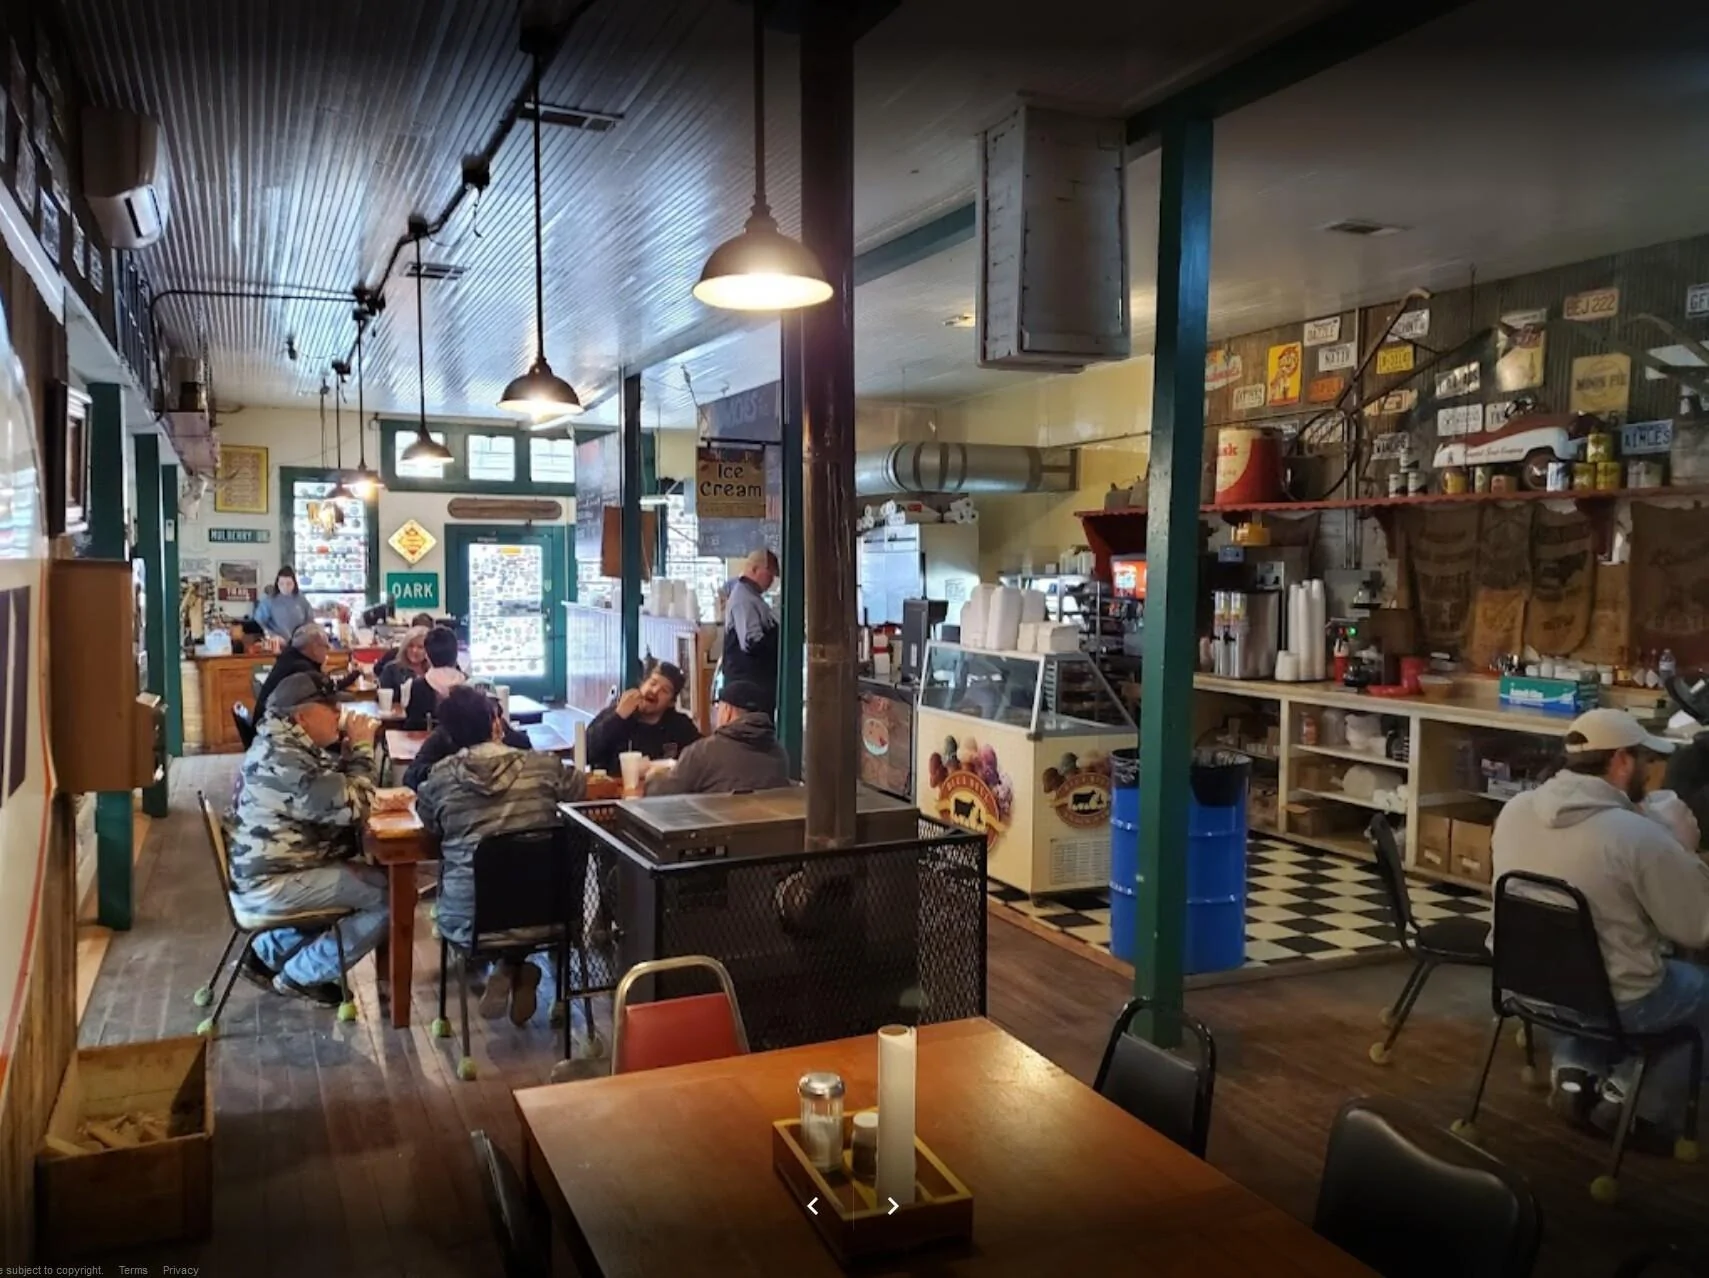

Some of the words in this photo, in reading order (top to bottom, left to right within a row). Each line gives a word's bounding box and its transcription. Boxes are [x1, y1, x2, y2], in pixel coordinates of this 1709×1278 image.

[1591, 294, 1616, 313] 222
[718, 463, 744, 479] Ice
[700, 481, 762, 498] Cream
[392, 582, 433, 599] OARK
